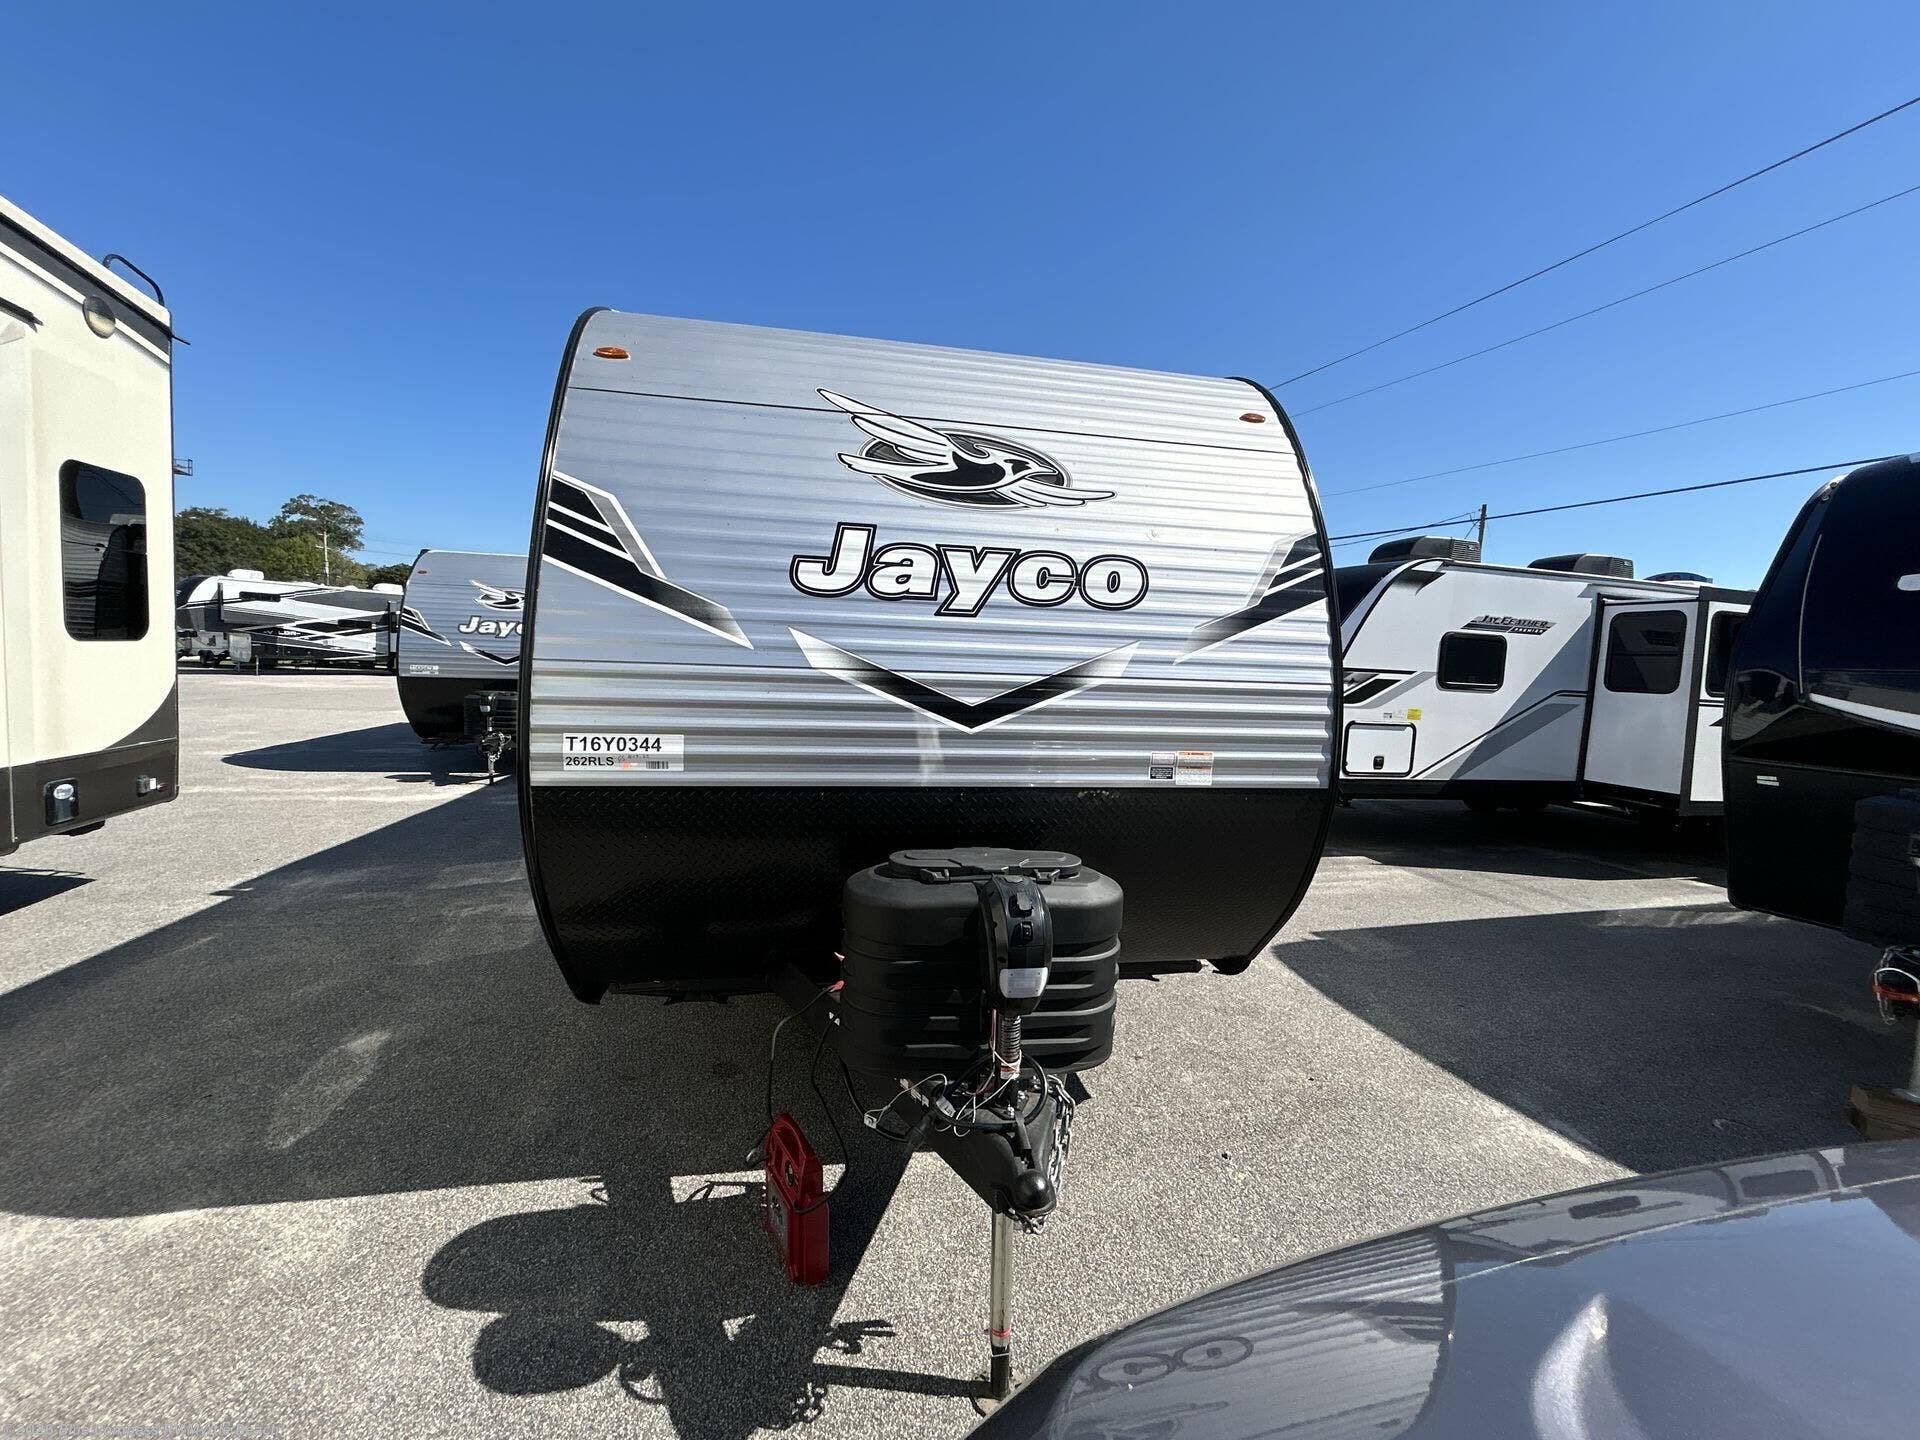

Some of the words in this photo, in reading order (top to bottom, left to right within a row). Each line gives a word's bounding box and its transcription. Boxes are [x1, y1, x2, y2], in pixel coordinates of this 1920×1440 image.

[789, 522, 1150, 617] Jayco
[565, 736, 662, 752] T16Y0344
[565, 756, 614, 766] 262RLS
